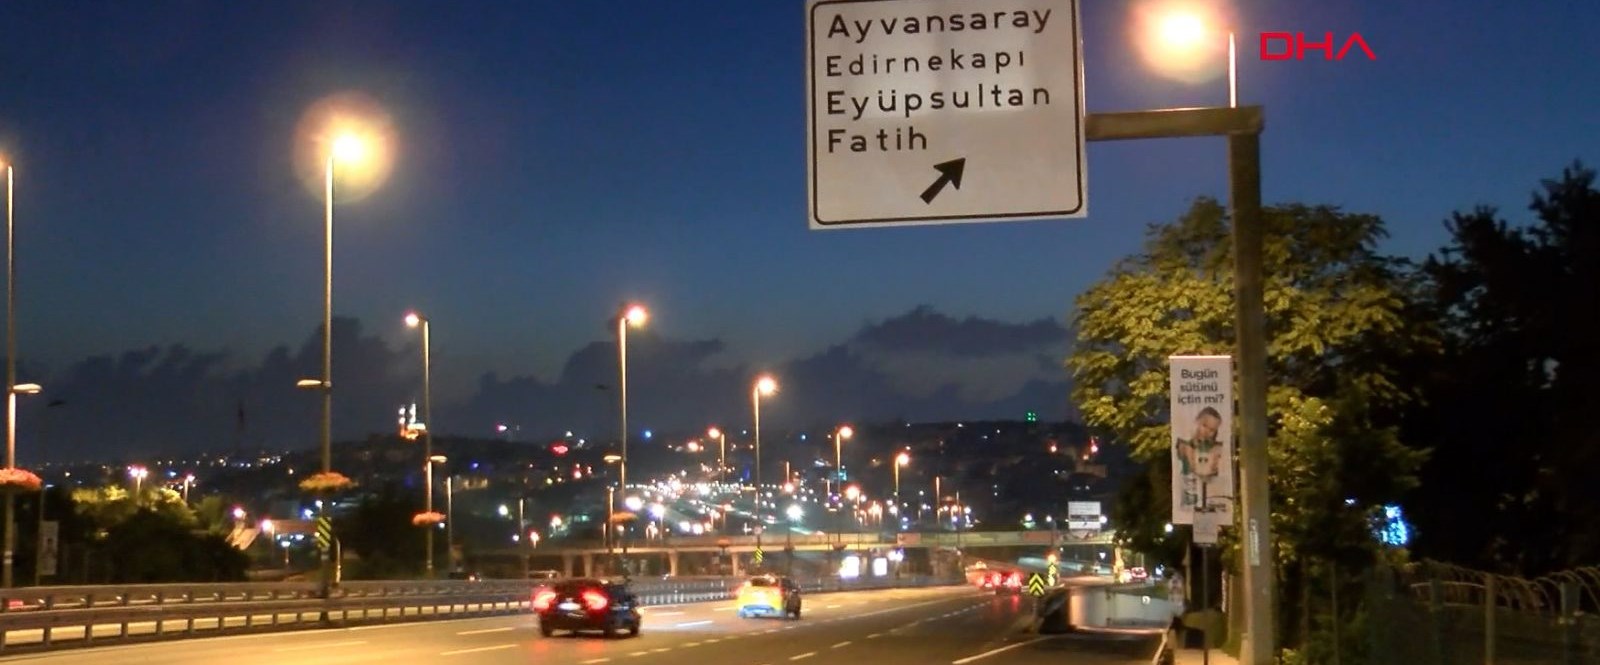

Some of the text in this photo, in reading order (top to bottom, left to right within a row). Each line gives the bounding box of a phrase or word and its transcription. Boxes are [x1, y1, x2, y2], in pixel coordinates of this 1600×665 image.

[827, 8, 1051, 44] Ayvansaray
[826, 48, 1024, 77] Edirnekapı
[827, 83, 1051, 121] Eyüpsultan
[828, 126, 928, 153] Fatih
[1180, 381, 1218, 392] sütünü
[1181, 368, 1218, 381] Bugün
[1177, 393, 1224, 405] içtin mi?
